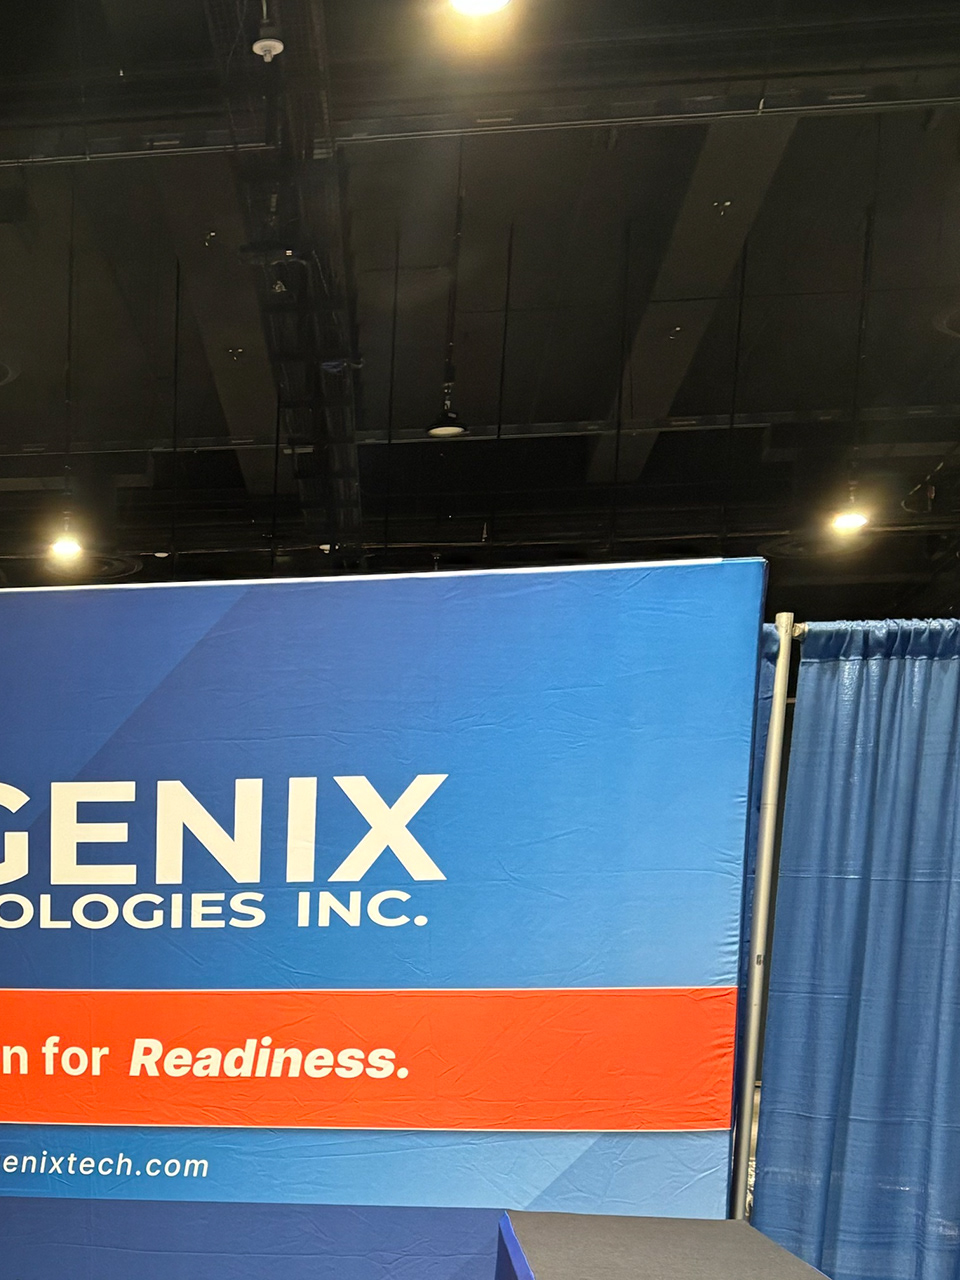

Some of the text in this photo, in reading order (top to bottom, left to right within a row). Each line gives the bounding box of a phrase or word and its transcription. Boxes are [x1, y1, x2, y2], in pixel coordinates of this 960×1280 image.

[297, 890, 428, 927] INC.
[42, 1036, 109, 1076] for
[129, 1036, 409, 1079] Readiness.
